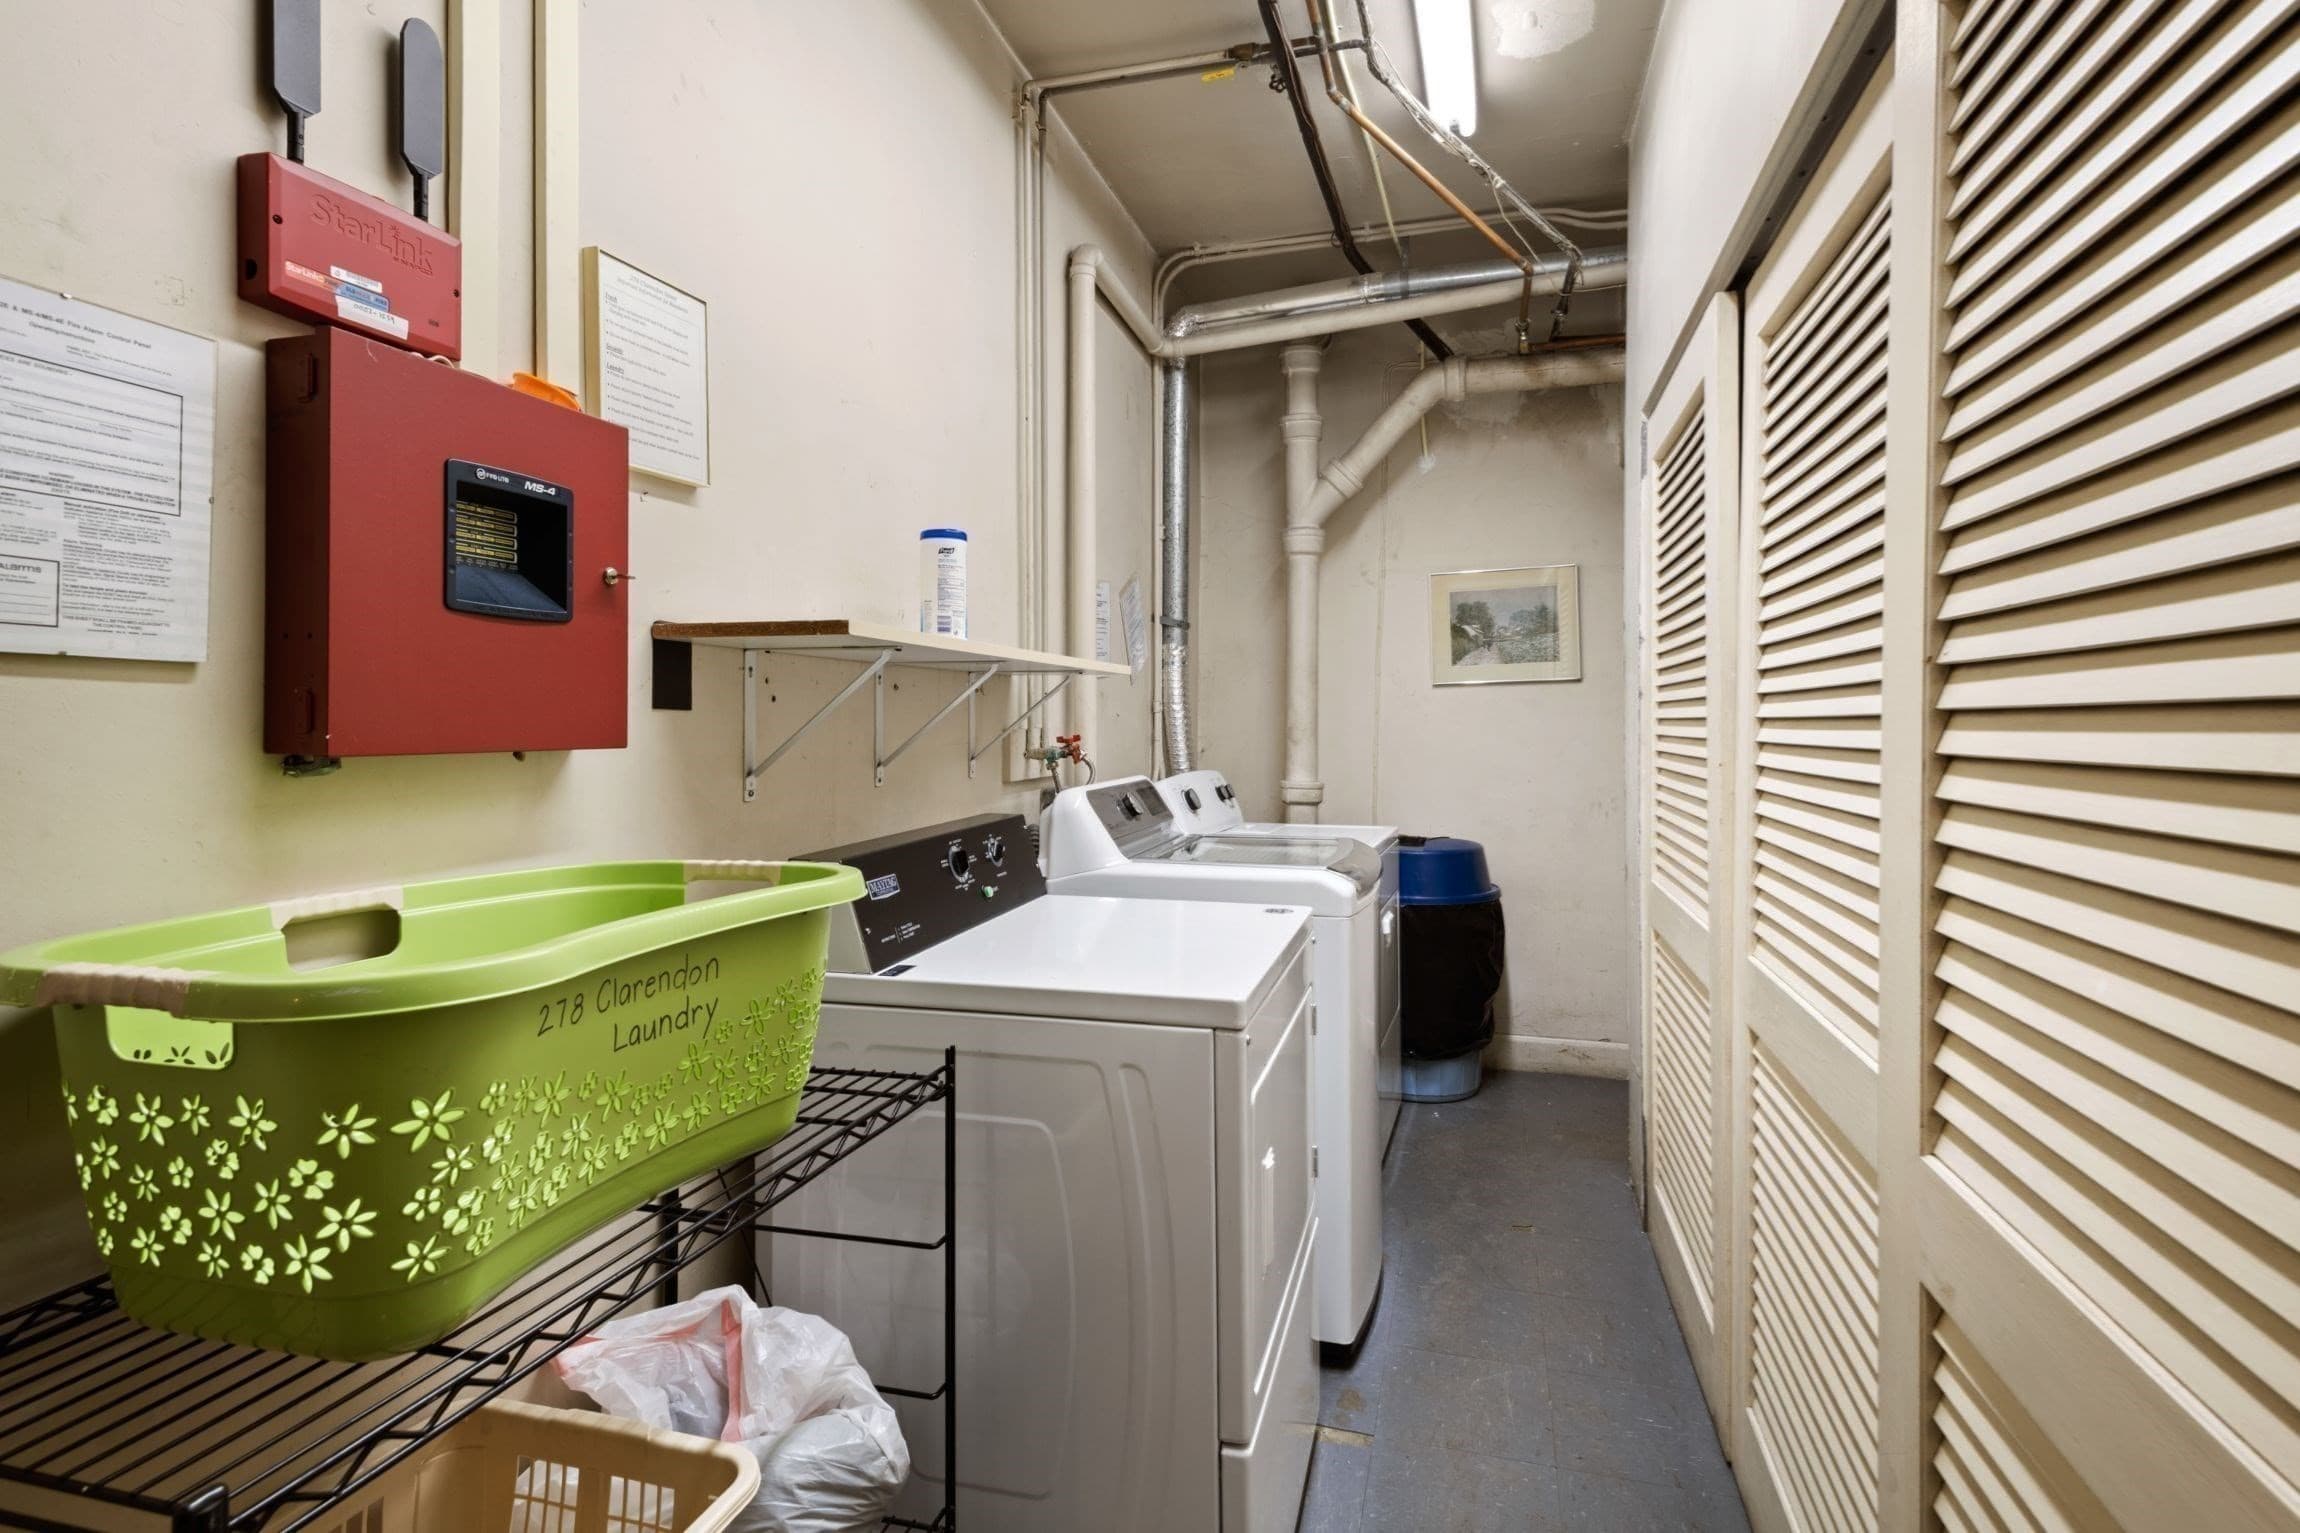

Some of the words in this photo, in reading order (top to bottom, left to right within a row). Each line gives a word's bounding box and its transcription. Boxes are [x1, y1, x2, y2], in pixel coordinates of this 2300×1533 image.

[311, 192, 434, 277] StarLink
[524, 480, 557, 496] MS-4
[537, 992, 585, 1038] 278
[597, 953, 720, 1014] Clarendon
[613, 995, 719, 1053] Laundry
